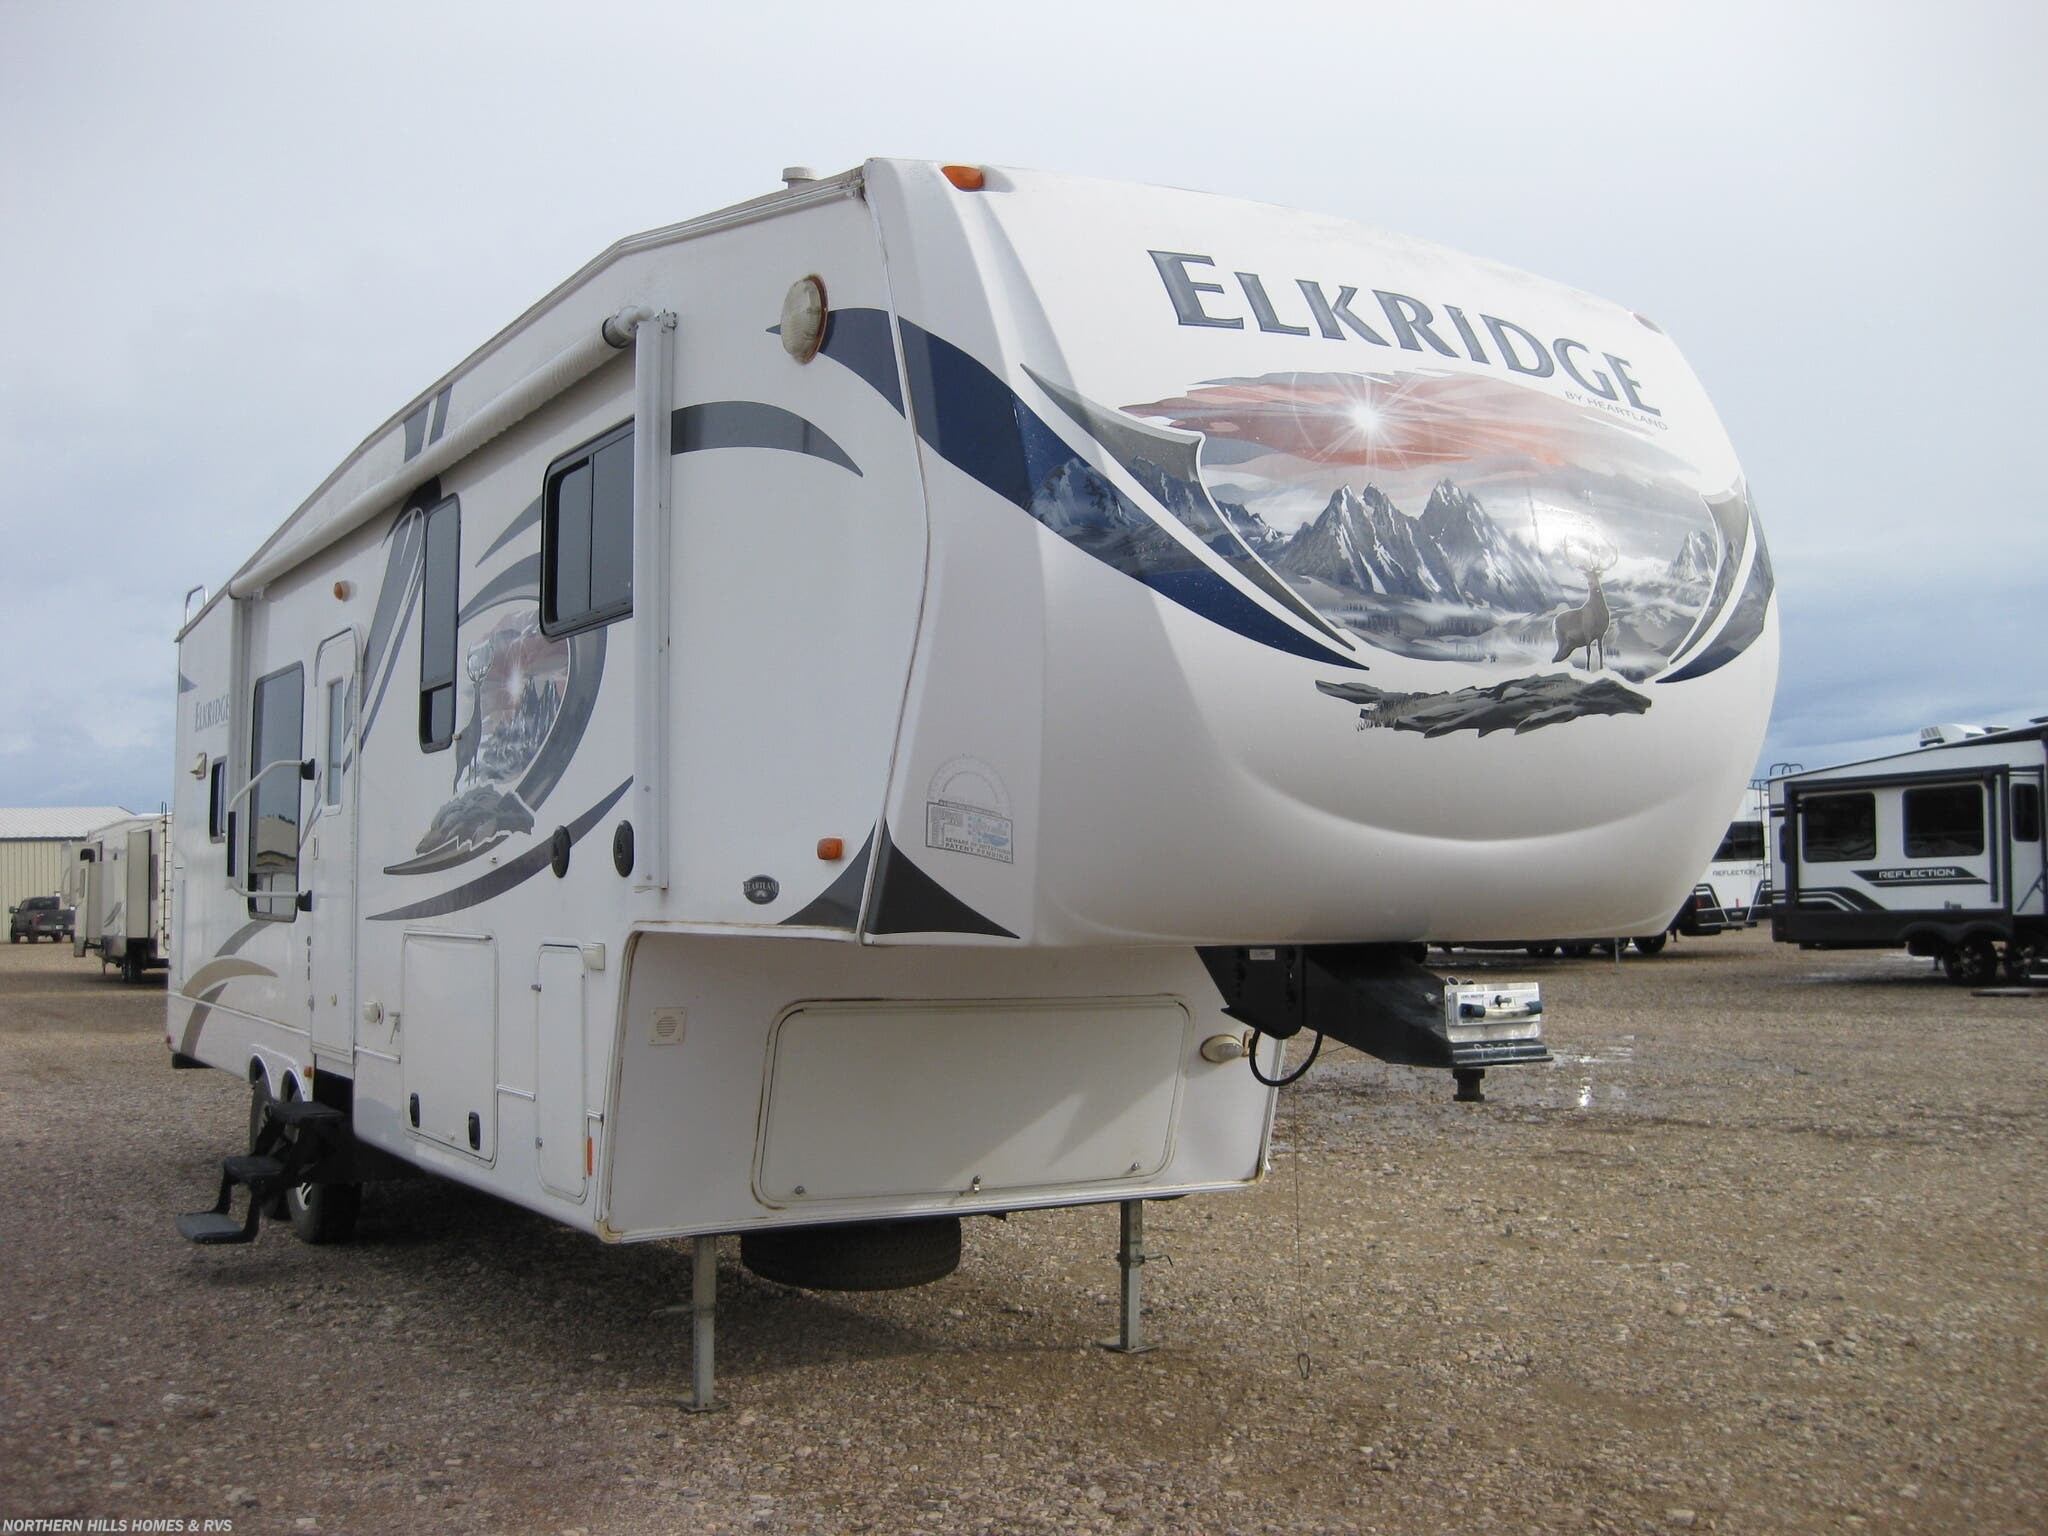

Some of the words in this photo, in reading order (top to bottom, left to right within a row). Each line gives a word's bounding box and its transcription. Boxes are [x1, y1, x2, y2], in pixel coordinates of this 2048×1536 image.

[1147, 250, 1662, 416] ELKRIDGE
[1565, 391, 1582, 400] BY
[1587, 398, 1668, 430] HEARTLAND
[1712, 869, 1756, 877] REFLECTION
[1879, 868, 1956, 879] REFLECTION
